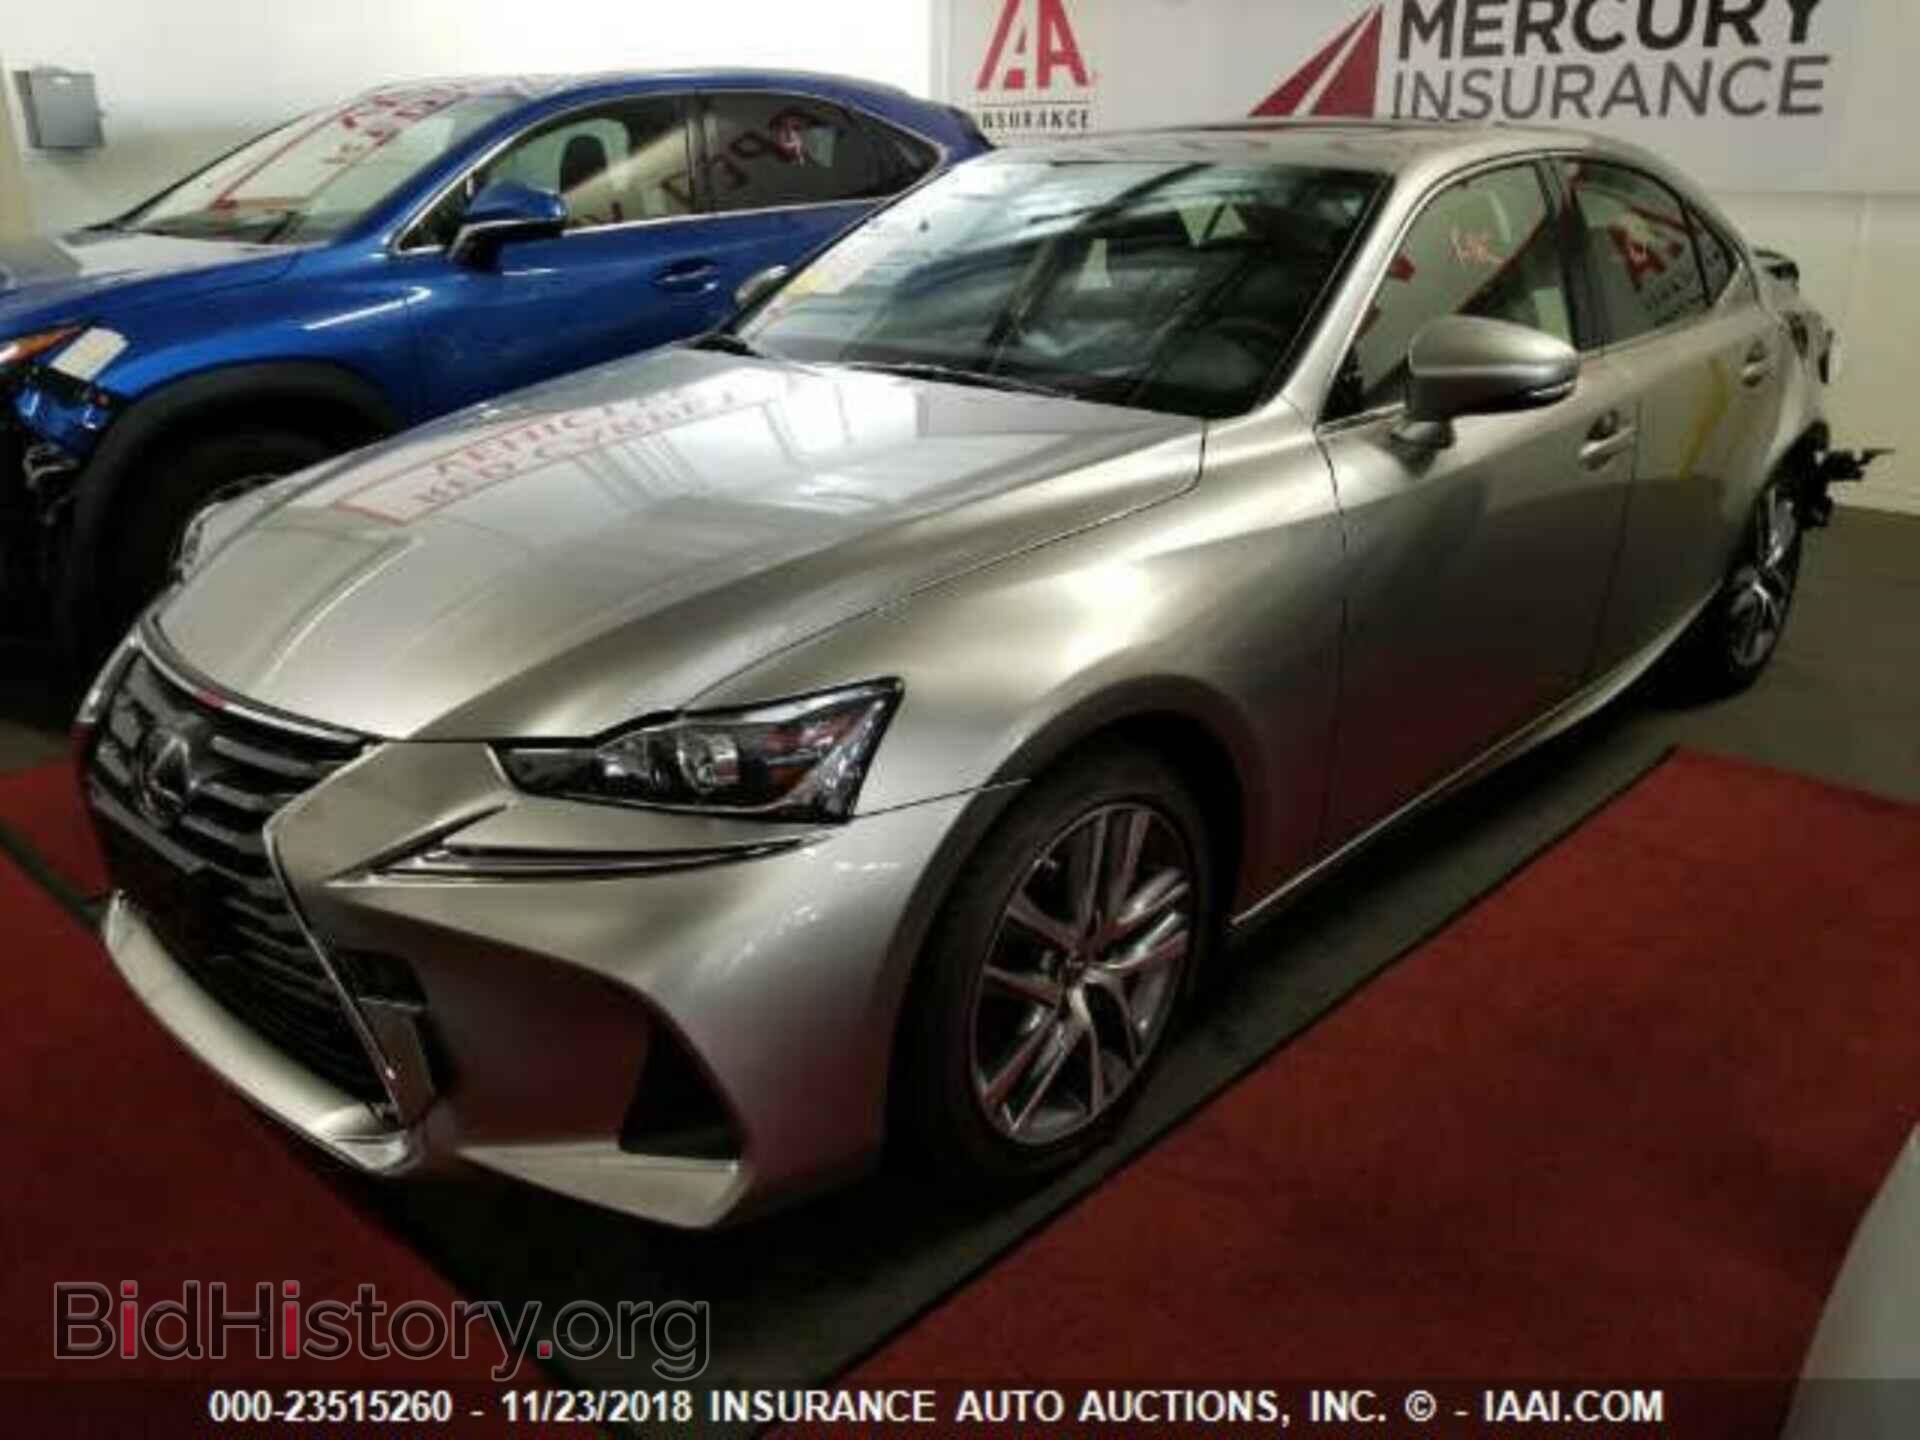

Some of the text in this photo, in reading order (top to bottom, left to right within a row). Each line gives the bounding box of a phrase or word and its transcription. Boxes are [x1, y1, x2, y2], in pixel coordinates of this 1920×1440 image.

[1399, 0, 1824, 61] MERCURY
[1389, 54, 1830, 121] INSURANCE
[981, 108, 1092, 129] NSURANCE
